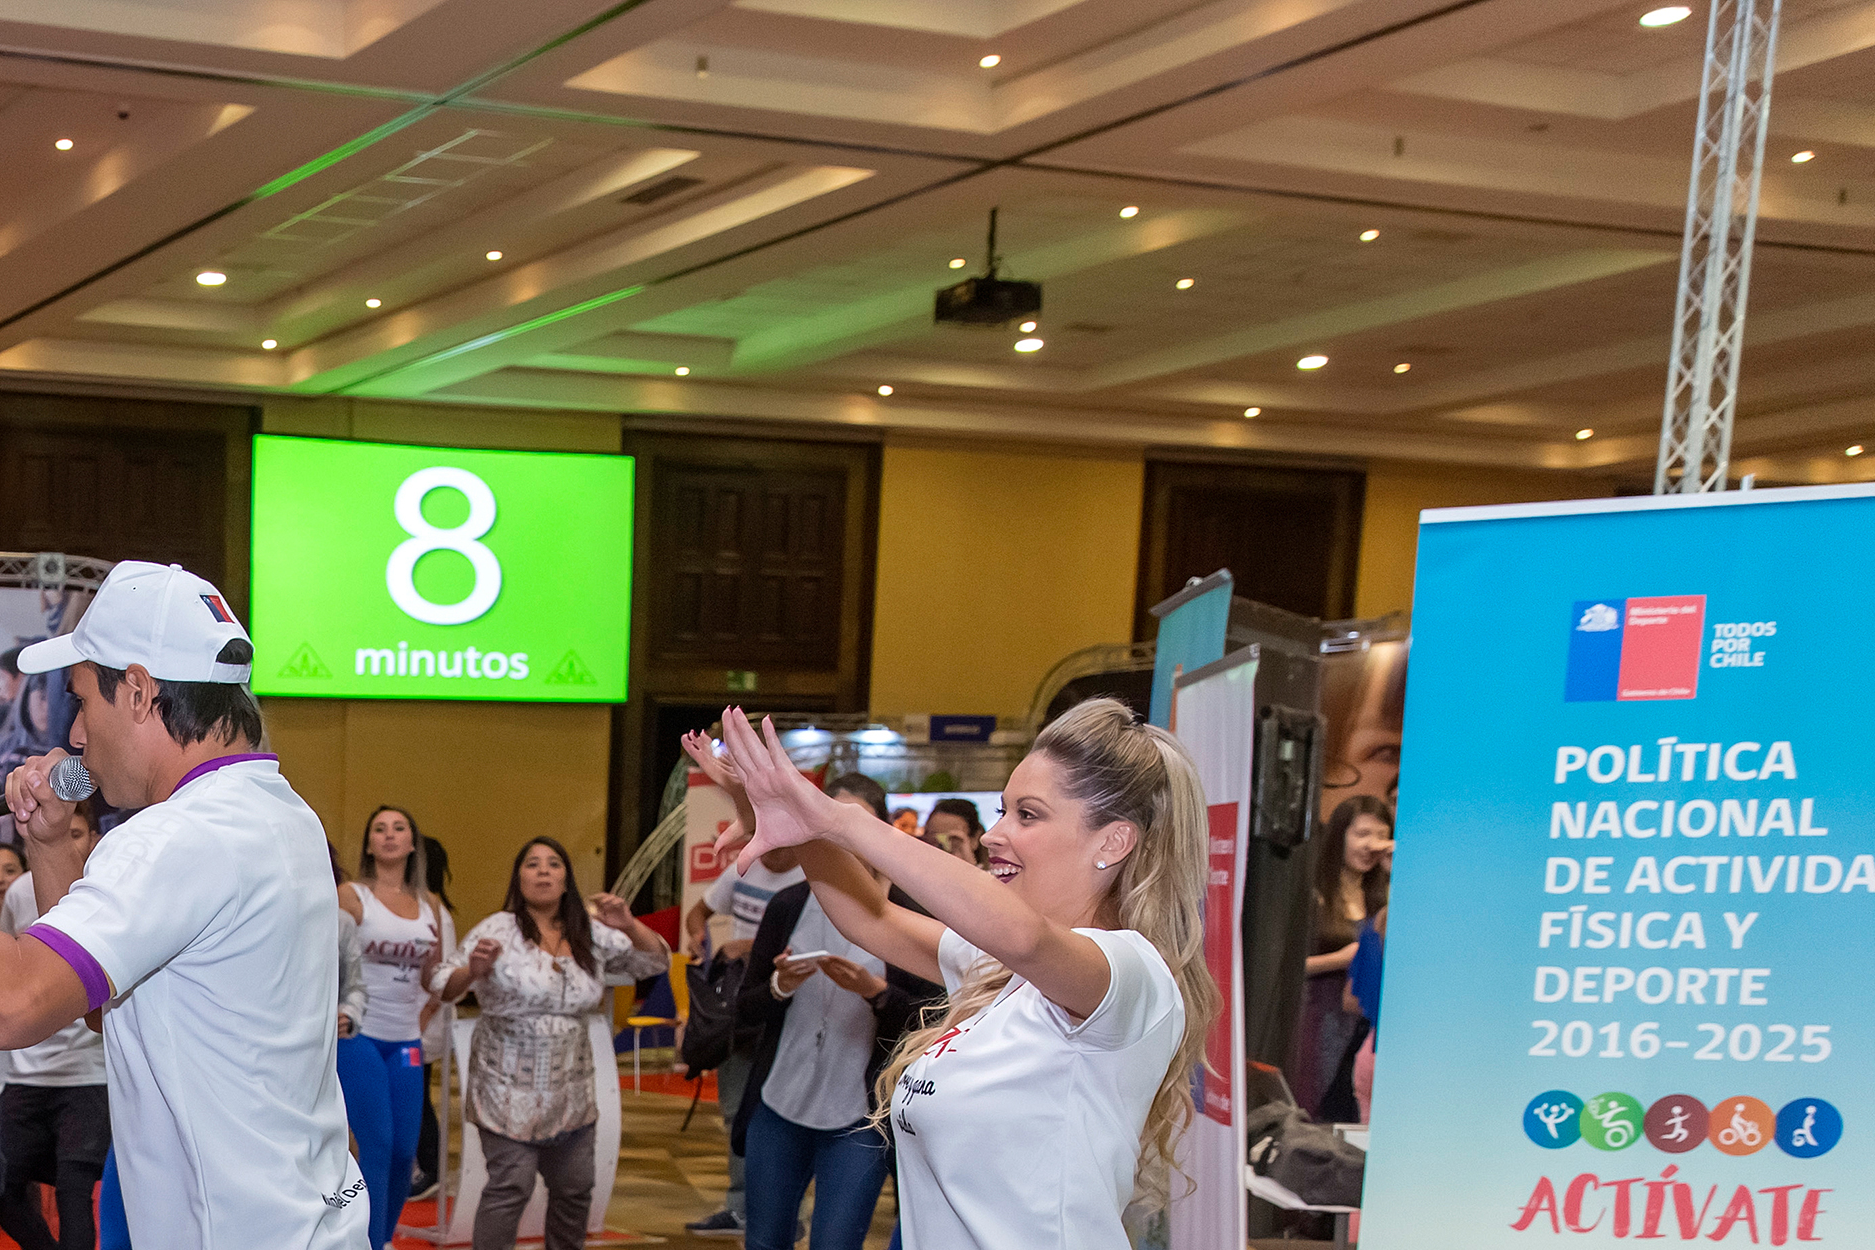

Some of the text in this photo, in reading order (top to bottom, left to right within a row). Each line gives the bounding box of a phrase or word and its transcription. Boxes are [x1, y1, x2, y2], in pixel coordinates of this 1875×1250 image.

[386, 466, 502, 625] 8
[1711, 637, 1752, 653] POR
[1713, 621, 1777, 638] TODOS
[355, 642, 529, 680] minutos
[1709, 651, 1766, 668] CHILE
[1554, 736, 1798, 784] POLÍTICA
[1549, 798, 1829, 839] NACIONAL
[1544, 856, 1615, 894] DE
[1539, 904, 1760, 950] FÍSICA Y
[1533, 965, 1771, 1006] DEPORTE
[1509, 1163, 1834, 1247] ACTÍVATE
